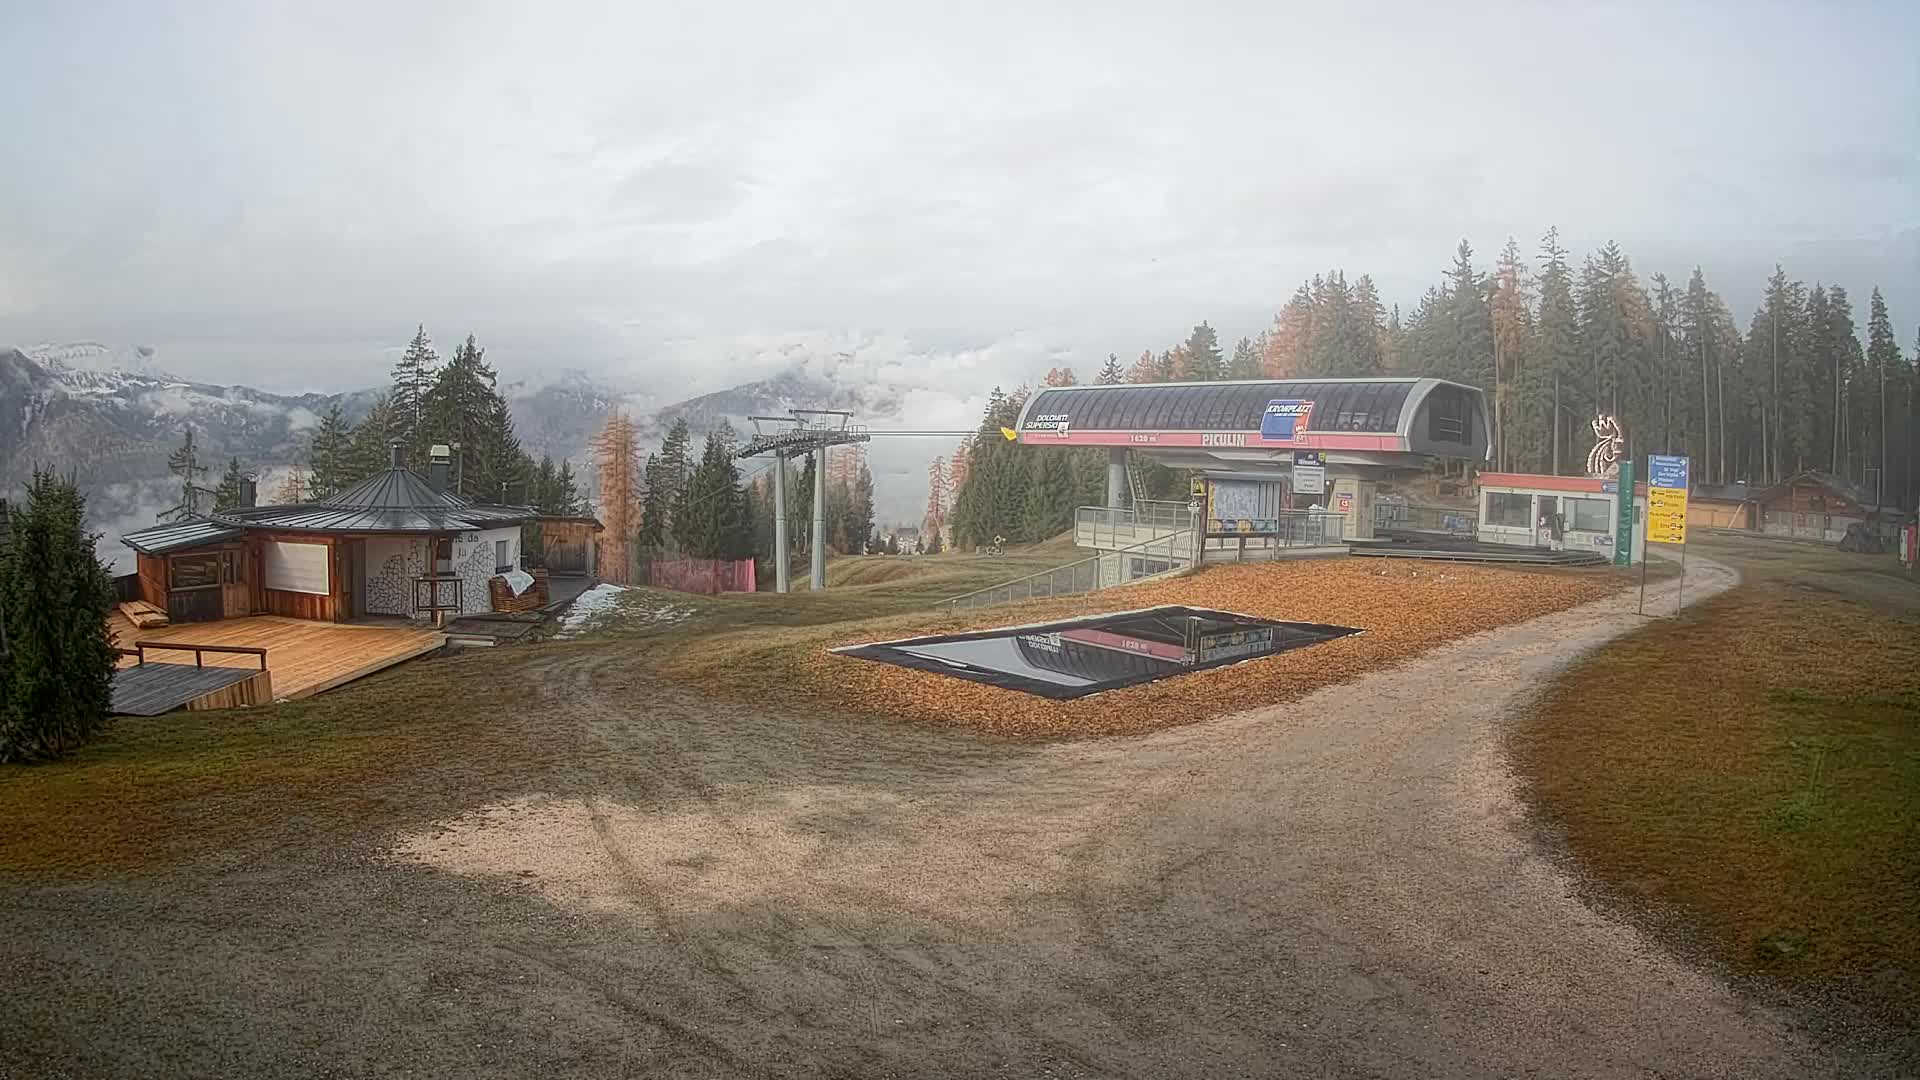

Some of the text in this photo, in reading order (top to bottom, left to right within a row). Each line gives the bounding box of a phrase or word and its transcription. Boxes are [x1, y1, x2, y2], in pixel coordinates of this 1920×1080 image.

[1266, 404, 1311, 413] KRONPLATZ
[1025, 421, 1059, 429] SUPERSKI
[1201, 434, 1245, 446] PICULIN
